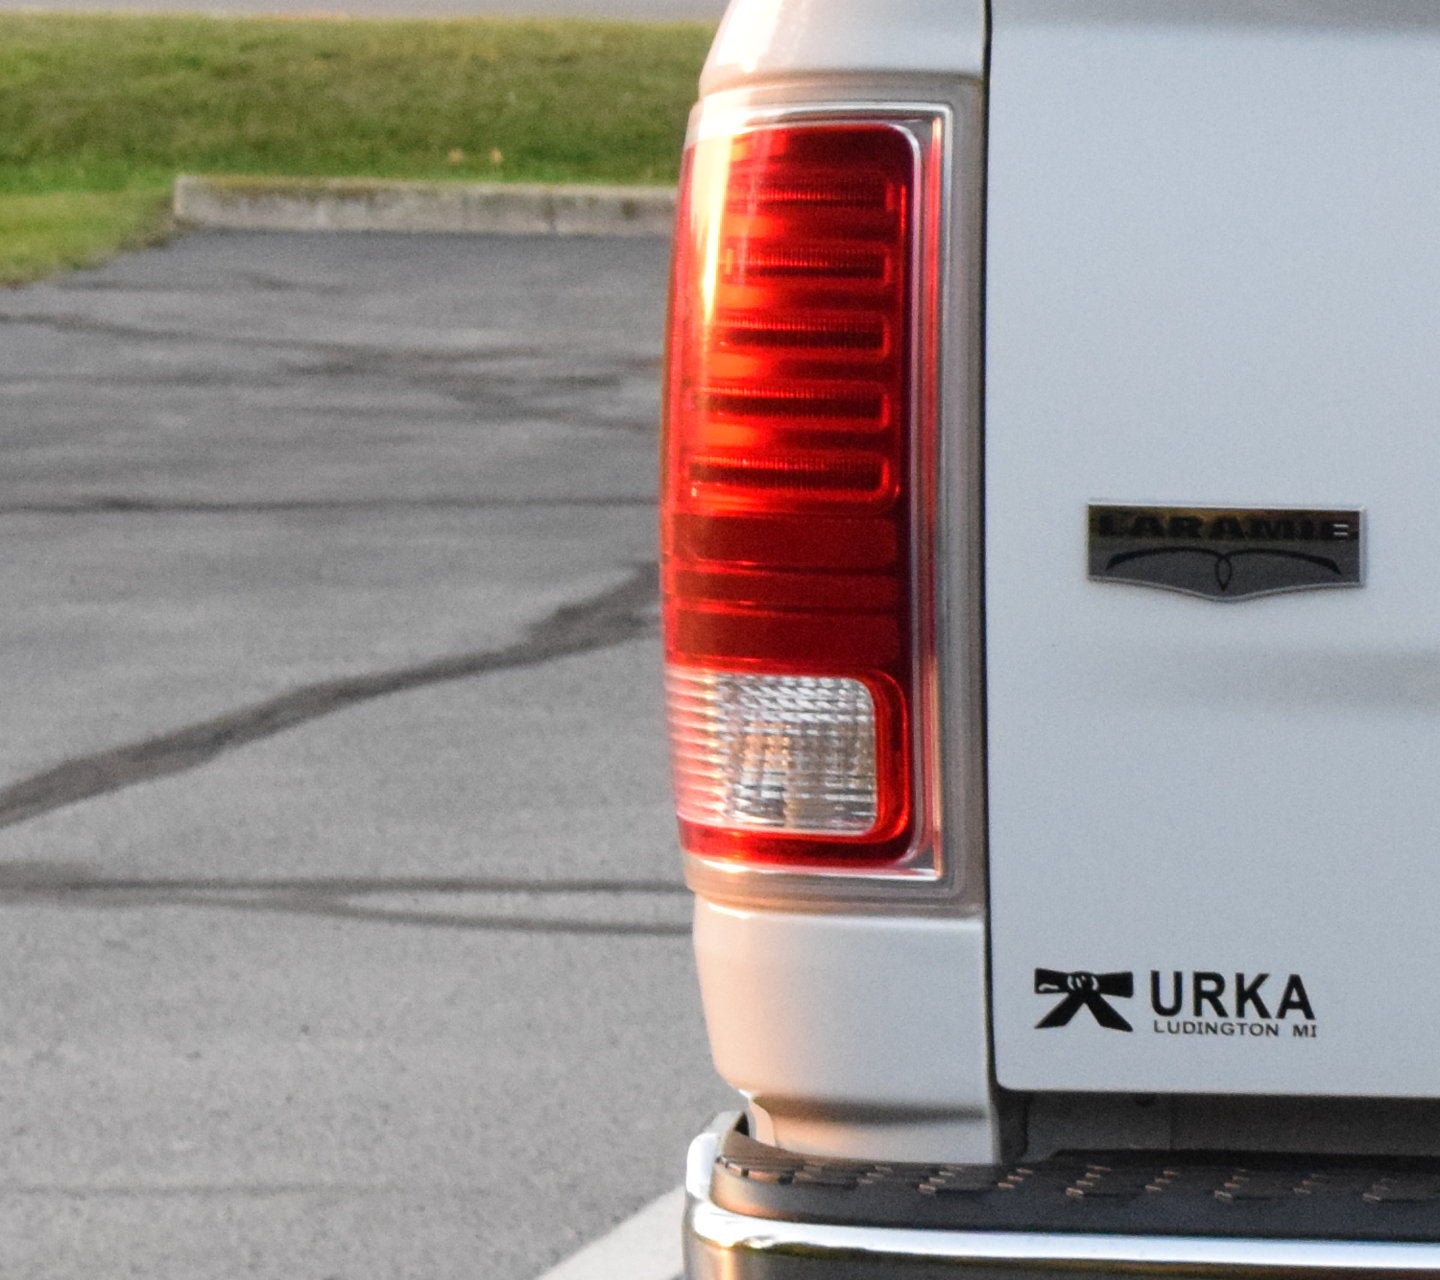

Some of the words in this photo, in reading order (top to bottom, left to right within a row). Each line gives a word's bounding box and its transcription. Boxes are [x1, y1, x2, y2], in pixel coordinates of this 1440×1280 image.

[1098, 514, 1349, 540] LARAMIE
[1150, 970, 1316, 1020] URKA
[1153, 1019, 1279, 1037] LUDINGTON
[1293, 1024, 1317, 1038] MI
